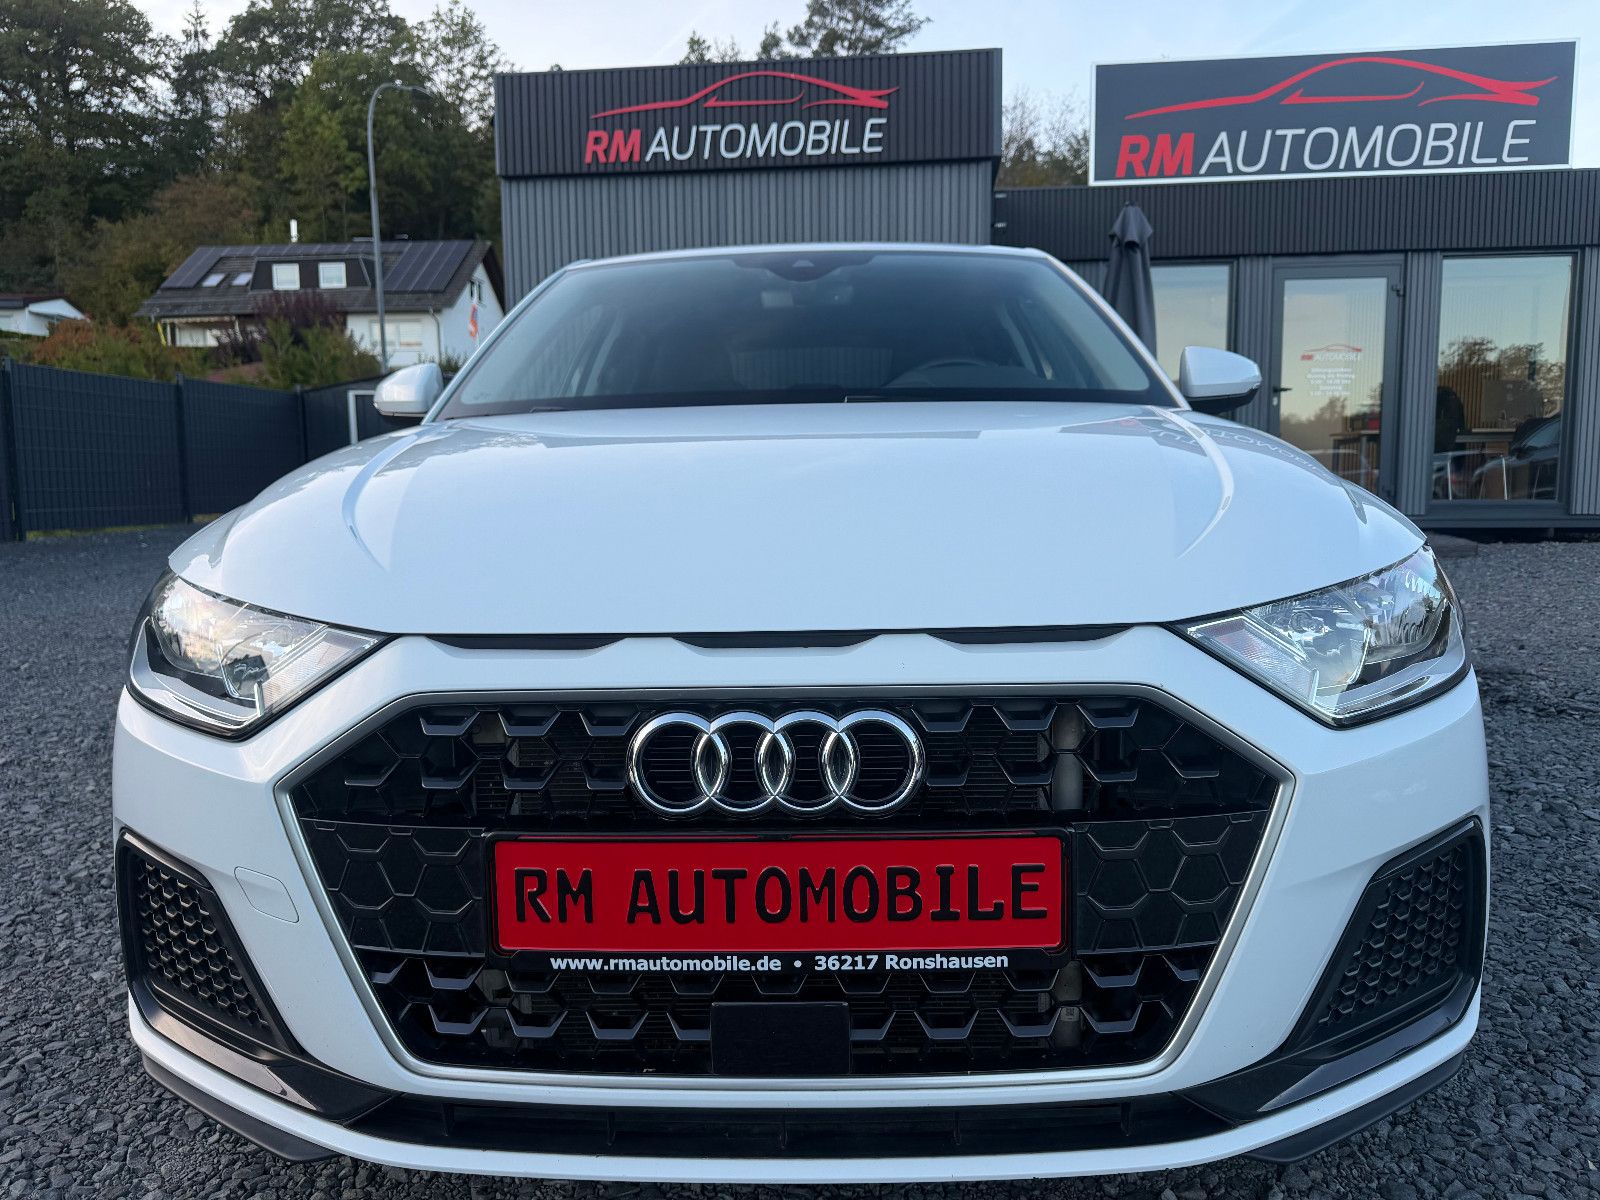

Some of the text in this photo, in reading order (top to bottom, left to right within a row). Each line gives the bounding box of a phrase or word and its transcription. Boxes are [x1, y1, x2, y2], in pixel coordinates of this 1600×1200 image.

[584, 117, 888, 164] RM AUTOMOBILE
[1115, 119, 1537, 179] RM AUTOMOBILE
[514, 863, 1049, 924] RM AUTOMOBILE
[550, 953, 1009, 972] www.rmautomobile.de 36217 Ronshausen
